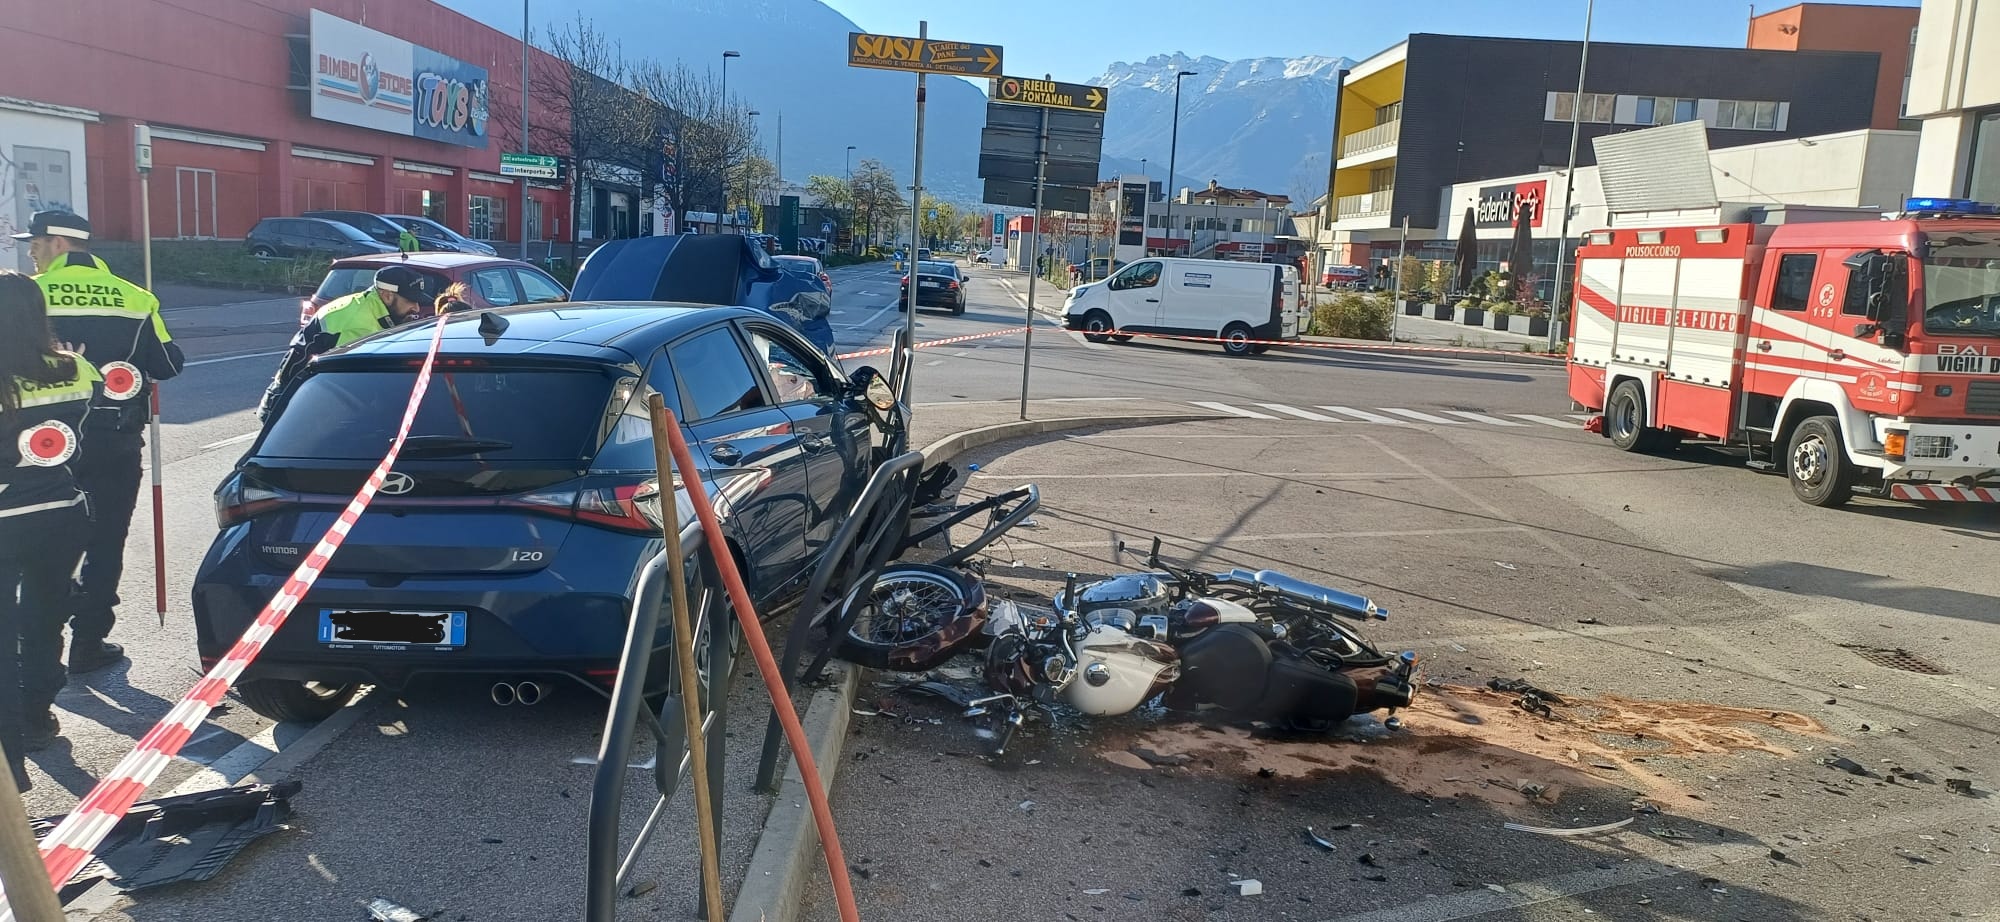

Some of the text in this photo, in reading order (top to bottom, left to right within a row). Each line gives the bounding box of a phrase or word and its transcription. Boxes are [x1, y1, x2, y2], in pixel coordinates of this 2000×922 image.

[855, 36, 923, 61] SOSI
[853, 58, 893, 66] LABORATORIO
[319, 54, 412, 96] BIMBO STORE
[1023, 79, 1056, 93] RIELLO
[418, 74, 469, 131] TOYS
[1022, 92, 1072, 106] FONTANARI
[1625, 246, 1681, 257] POLISOCCORSO
[49, 284, 122, 296] POLIZIA
[50, 295, 124, 307] LOCALE
[1621, 306, 1736, 332] VIGILI DEL FUOCO
[1813, 307, 1834, 318] 115
[1937, 344, 1987, 356] BAI
[1937, 356, 1982, 373] VIGILI
[262, 545, 298, 555] HYUNDAI
